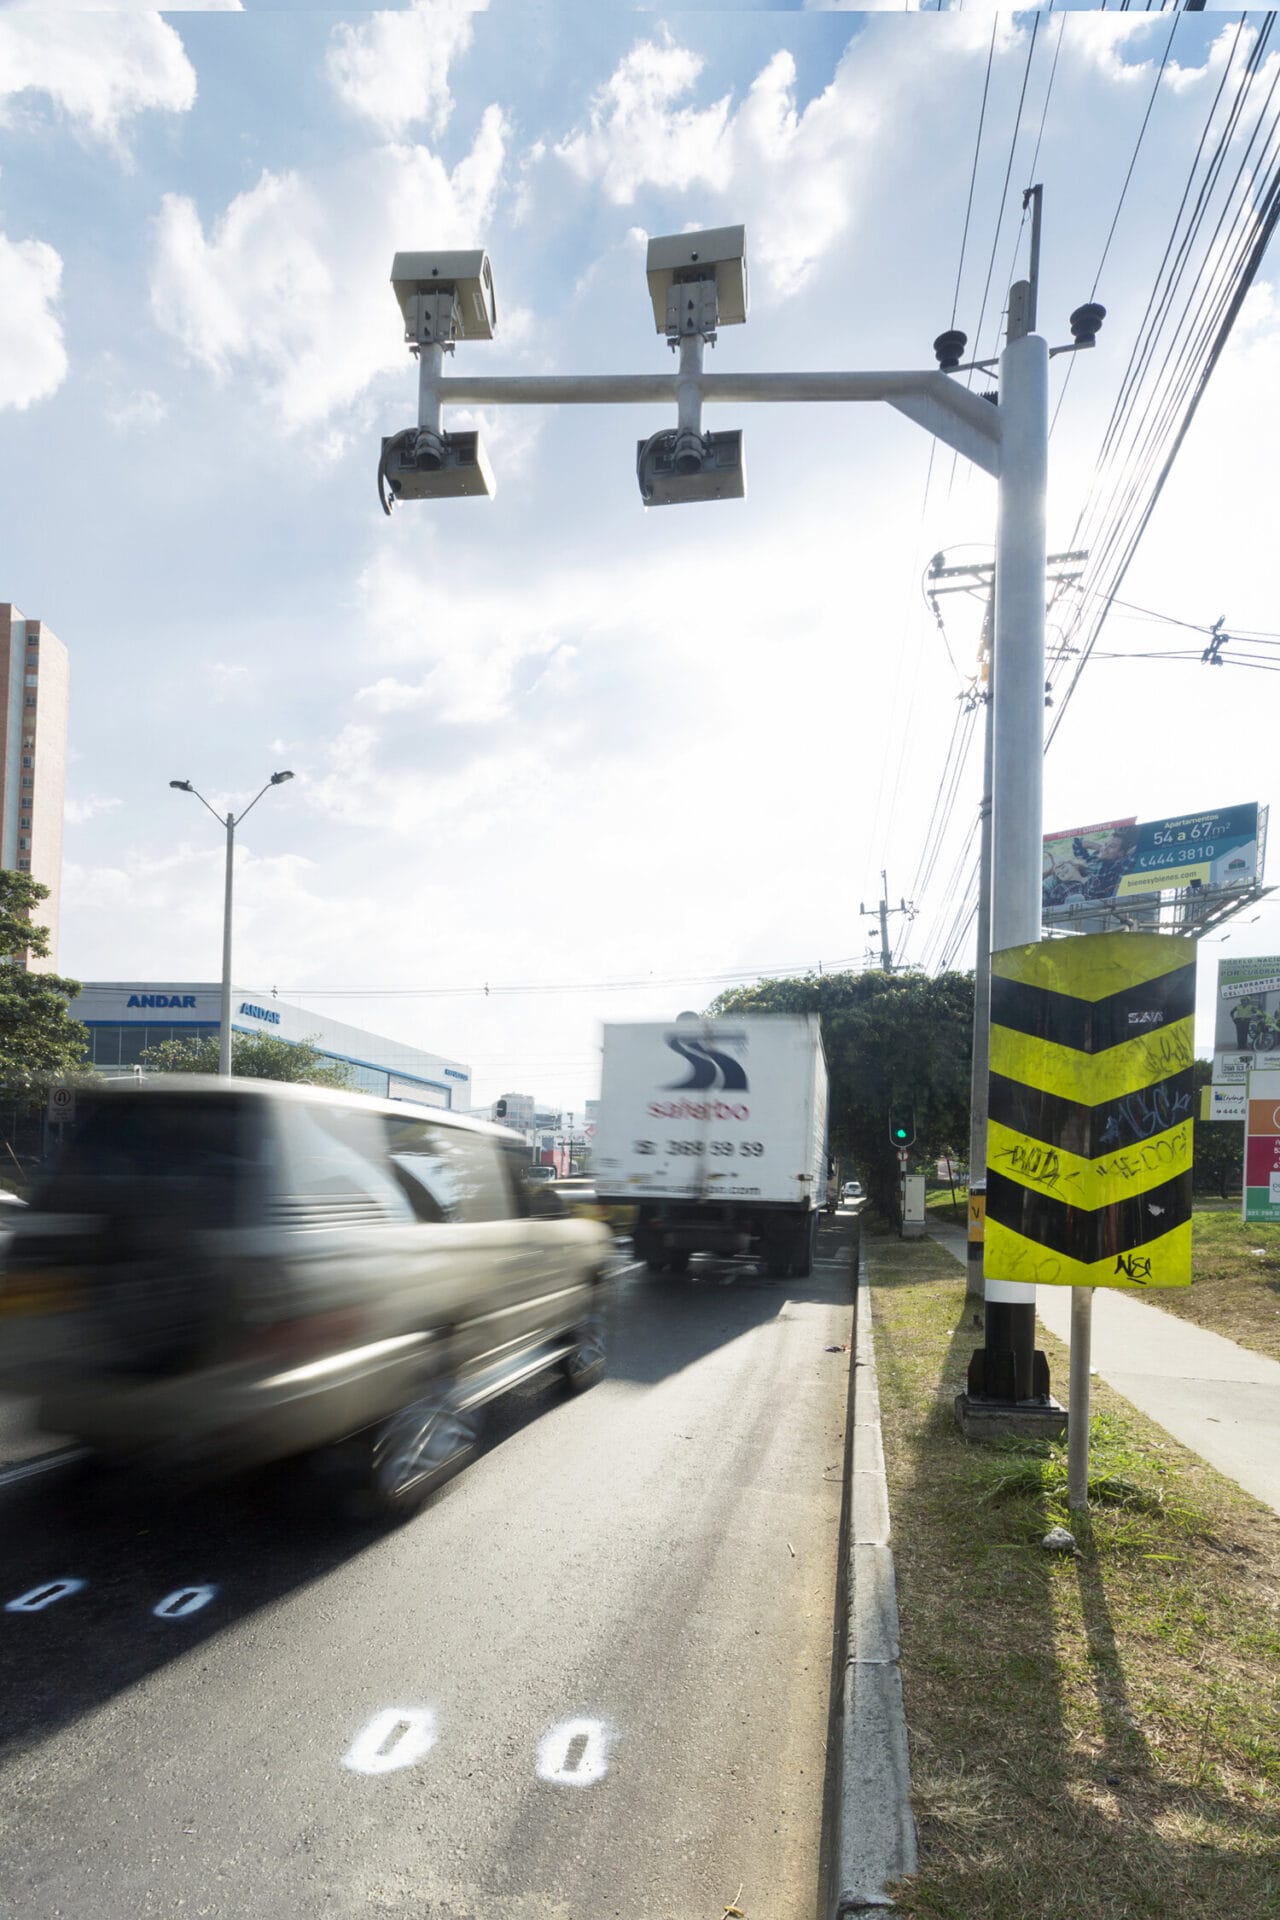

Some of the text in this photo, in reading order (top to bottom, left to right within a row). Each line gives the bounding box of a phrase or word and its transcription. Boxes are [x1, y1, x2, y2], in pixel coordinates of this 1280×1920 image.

[1164, 814, 1219, 829] Apartamentos
[1153, 830, 1173, 845] 54
[1177, 832, 1187, 841] a
[1148, 845, 1215, 867] 444 3810
[126, 995, 198, 1009] ANDAR
[240, 1003, 281, 1025] ANDAR
[739, 1140, 764, 1158] 59
